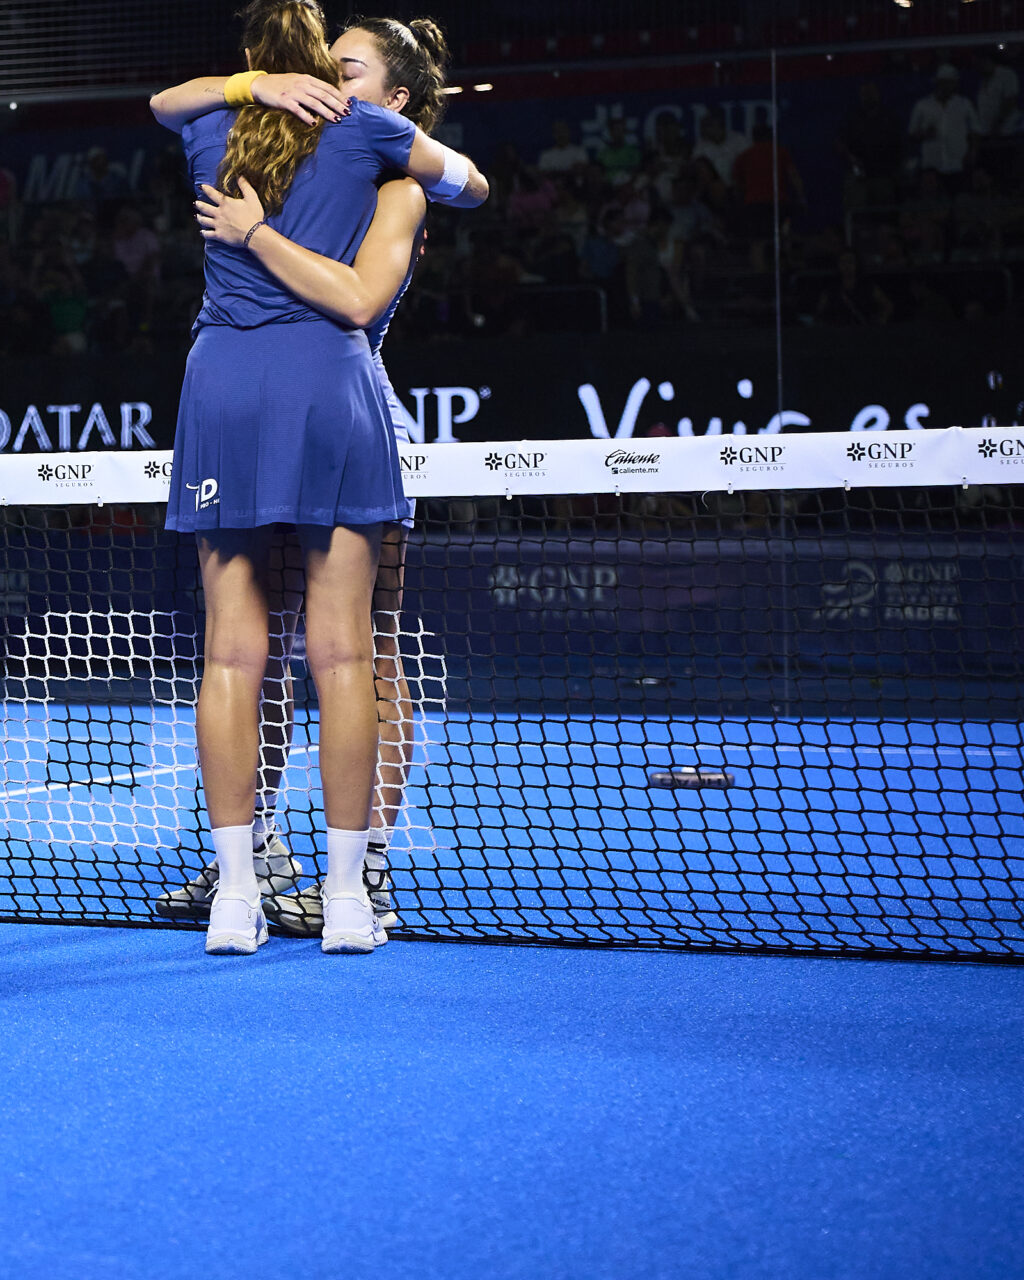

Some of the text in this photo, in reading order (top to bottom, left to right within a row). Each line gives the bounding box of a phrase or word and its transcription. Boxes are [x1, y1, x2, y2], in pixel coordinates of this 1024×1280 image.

[394, 387, 480, 443] NP
[604, 449, 661, 468] Caliente
[739, 446, 785, 463] GNP
[867, 442, 914, 460] GNP
[400, 455, 429, 471] NP
[504, 452, 548, 469] GNP
[54, 463, 94, 480] GNP
[907, 564, 958, 581] GNP
[529, 566, 617, 601] GNP
[884, 606, 959, 620] PADEL
